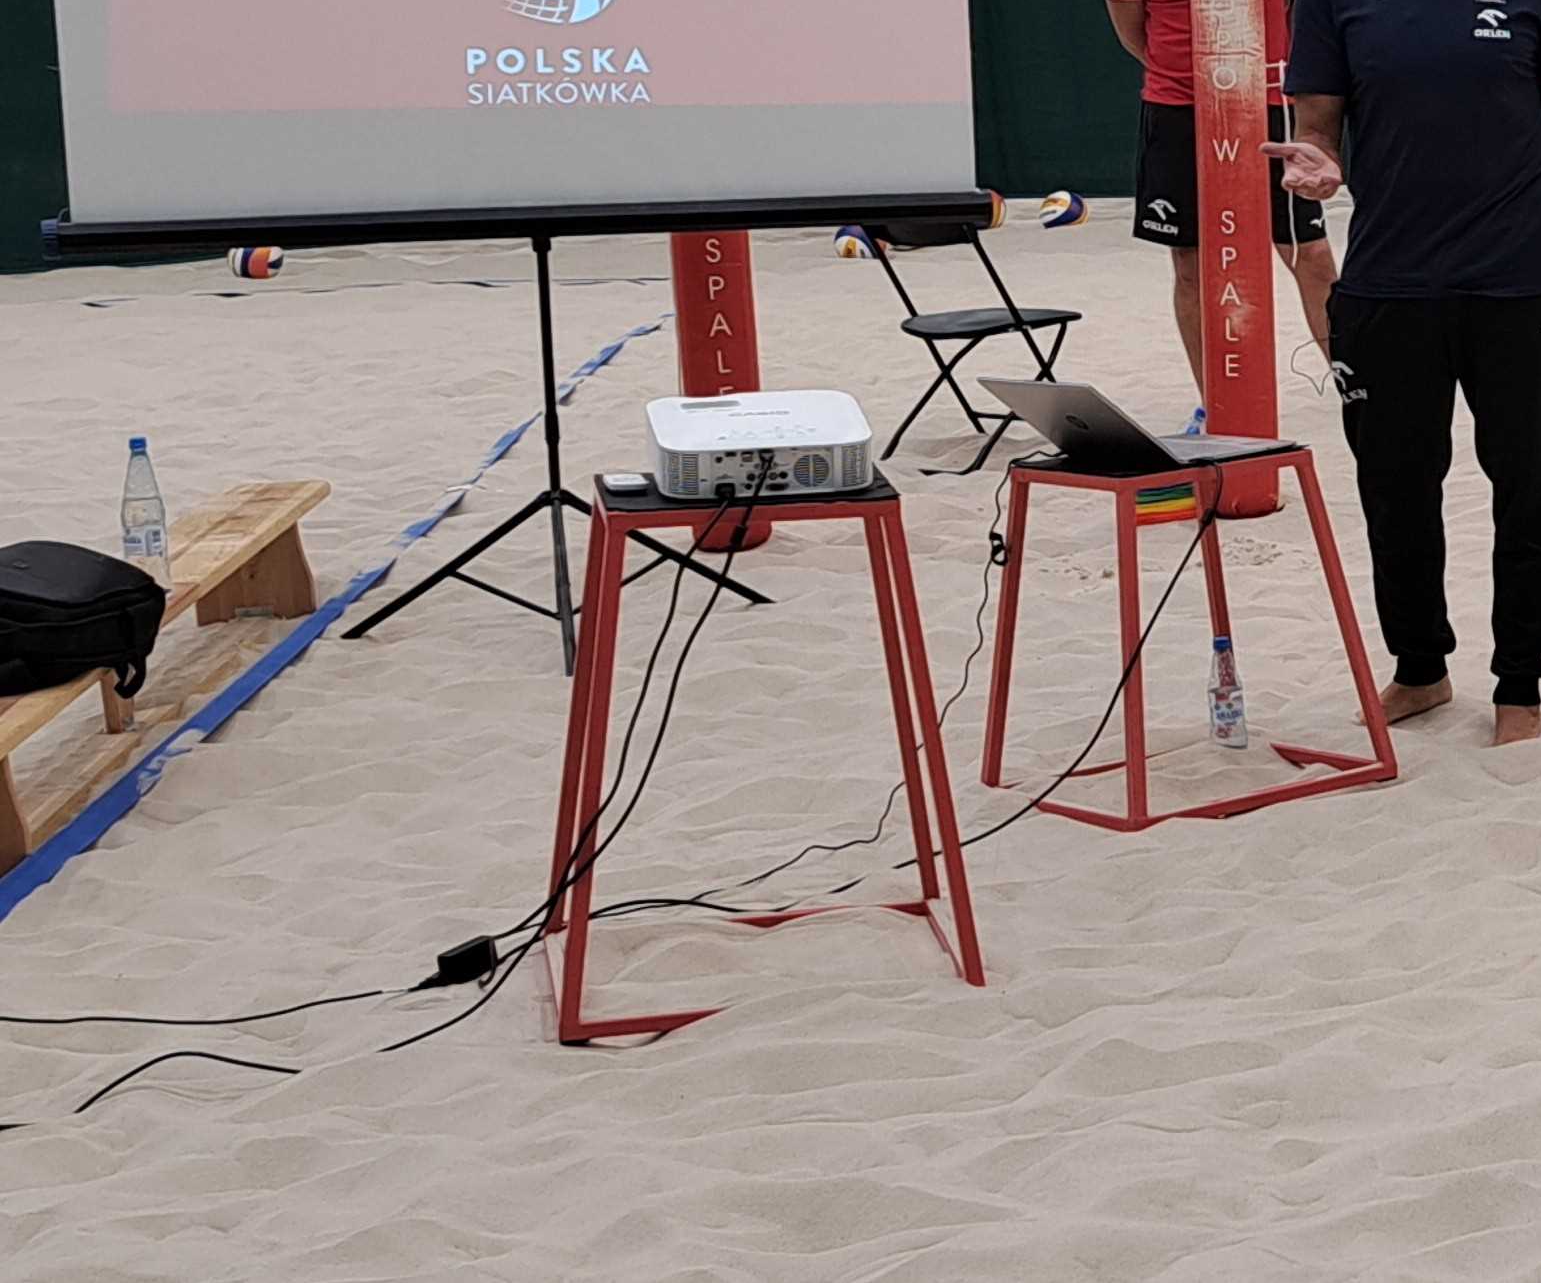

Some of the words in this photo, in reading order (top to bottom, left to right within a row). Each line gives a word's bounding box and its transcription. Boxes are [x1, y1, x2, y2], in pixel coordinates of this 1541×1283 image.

[465, 47, 650, 74] POLSKA
[467, 77, 650, 104] SIATKÓWKA
[1212, 139, 1240, 162] W
[1220, 210, 1241, 378] SPALE
